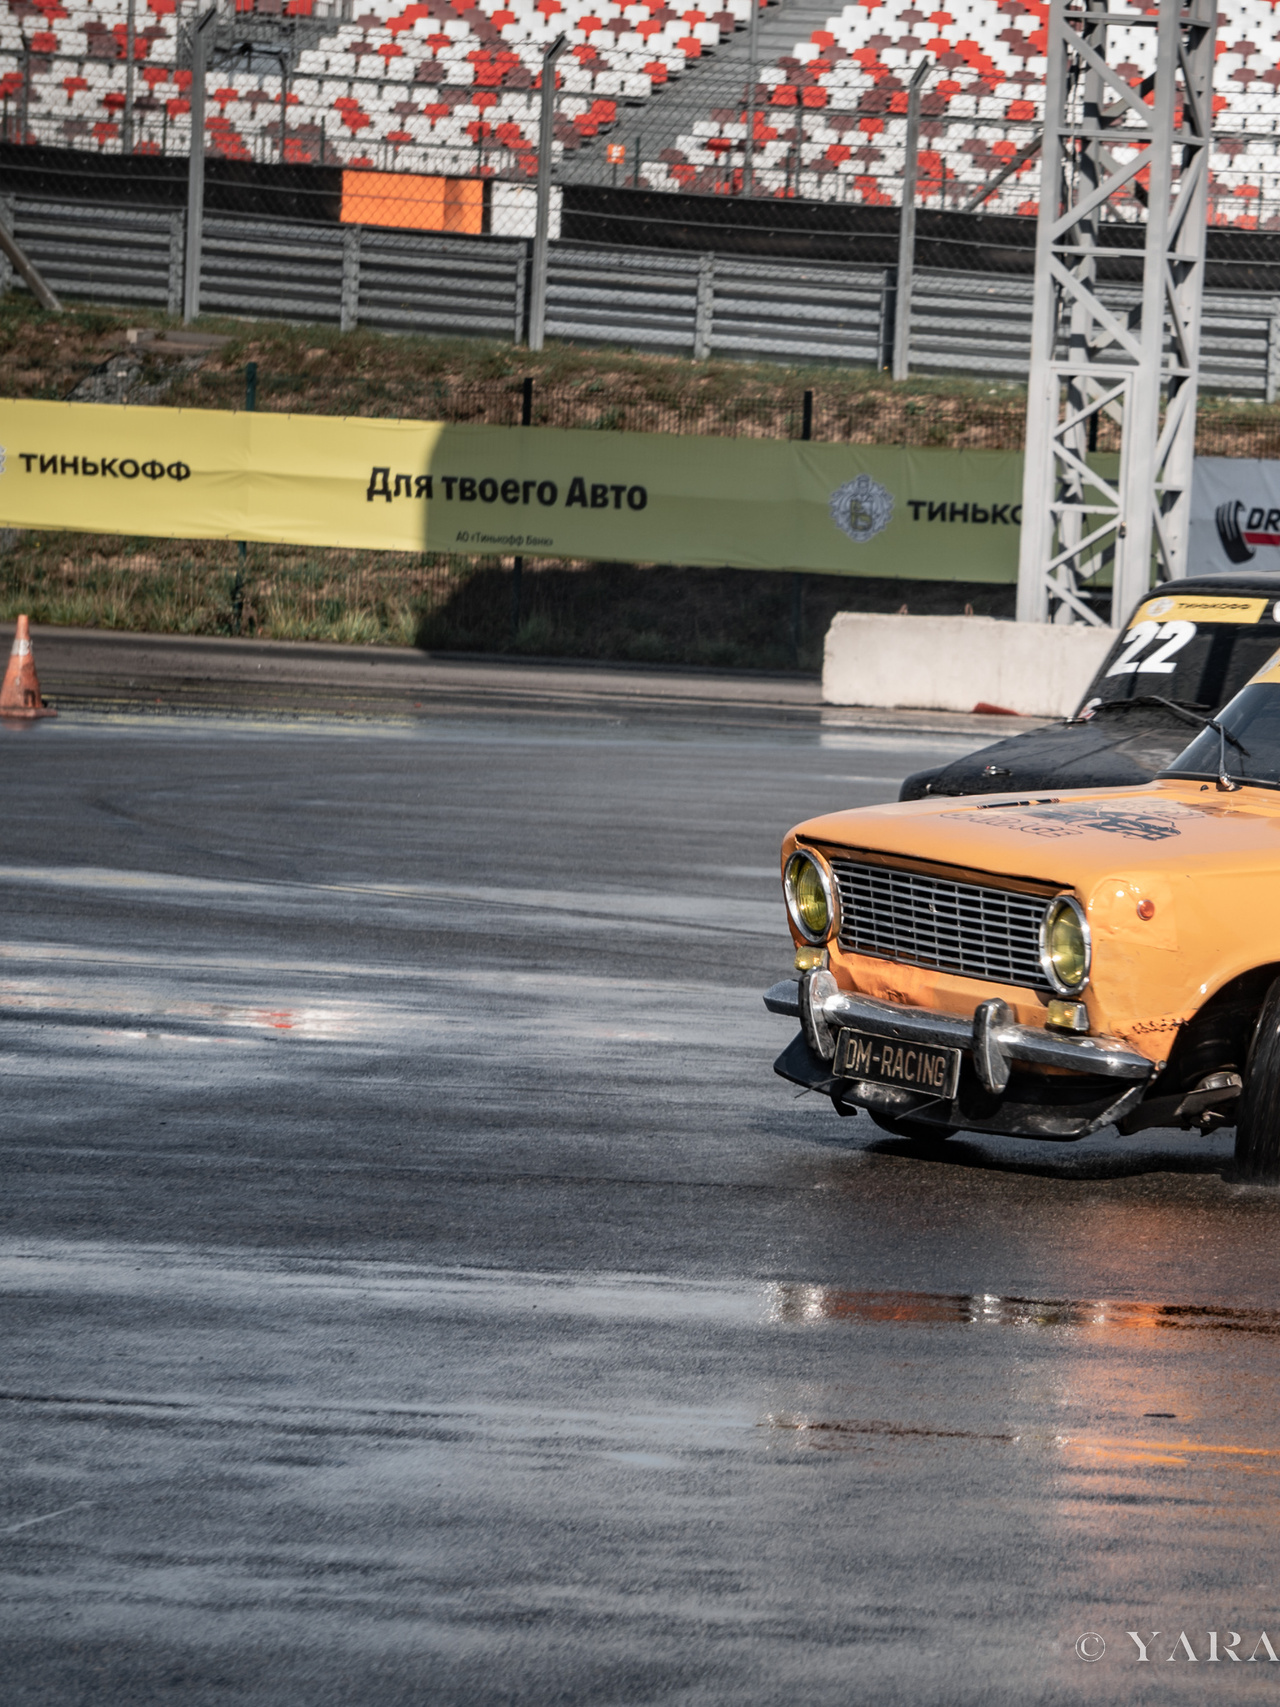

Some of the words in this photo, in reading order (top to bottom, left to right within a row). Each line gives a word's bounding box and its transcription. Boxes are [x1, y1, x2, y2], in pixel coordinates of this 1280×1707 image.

[18, 453, 191, 481] ТИНЬКОФФ
[367, 467, 433, 503] Для
[441, 476, 558, 507] твоего
[565, 477, 648, 511] Авто
[1104, 620, 1198, 679] 22
[843, 1038, 947, 1088] DM-RACING
